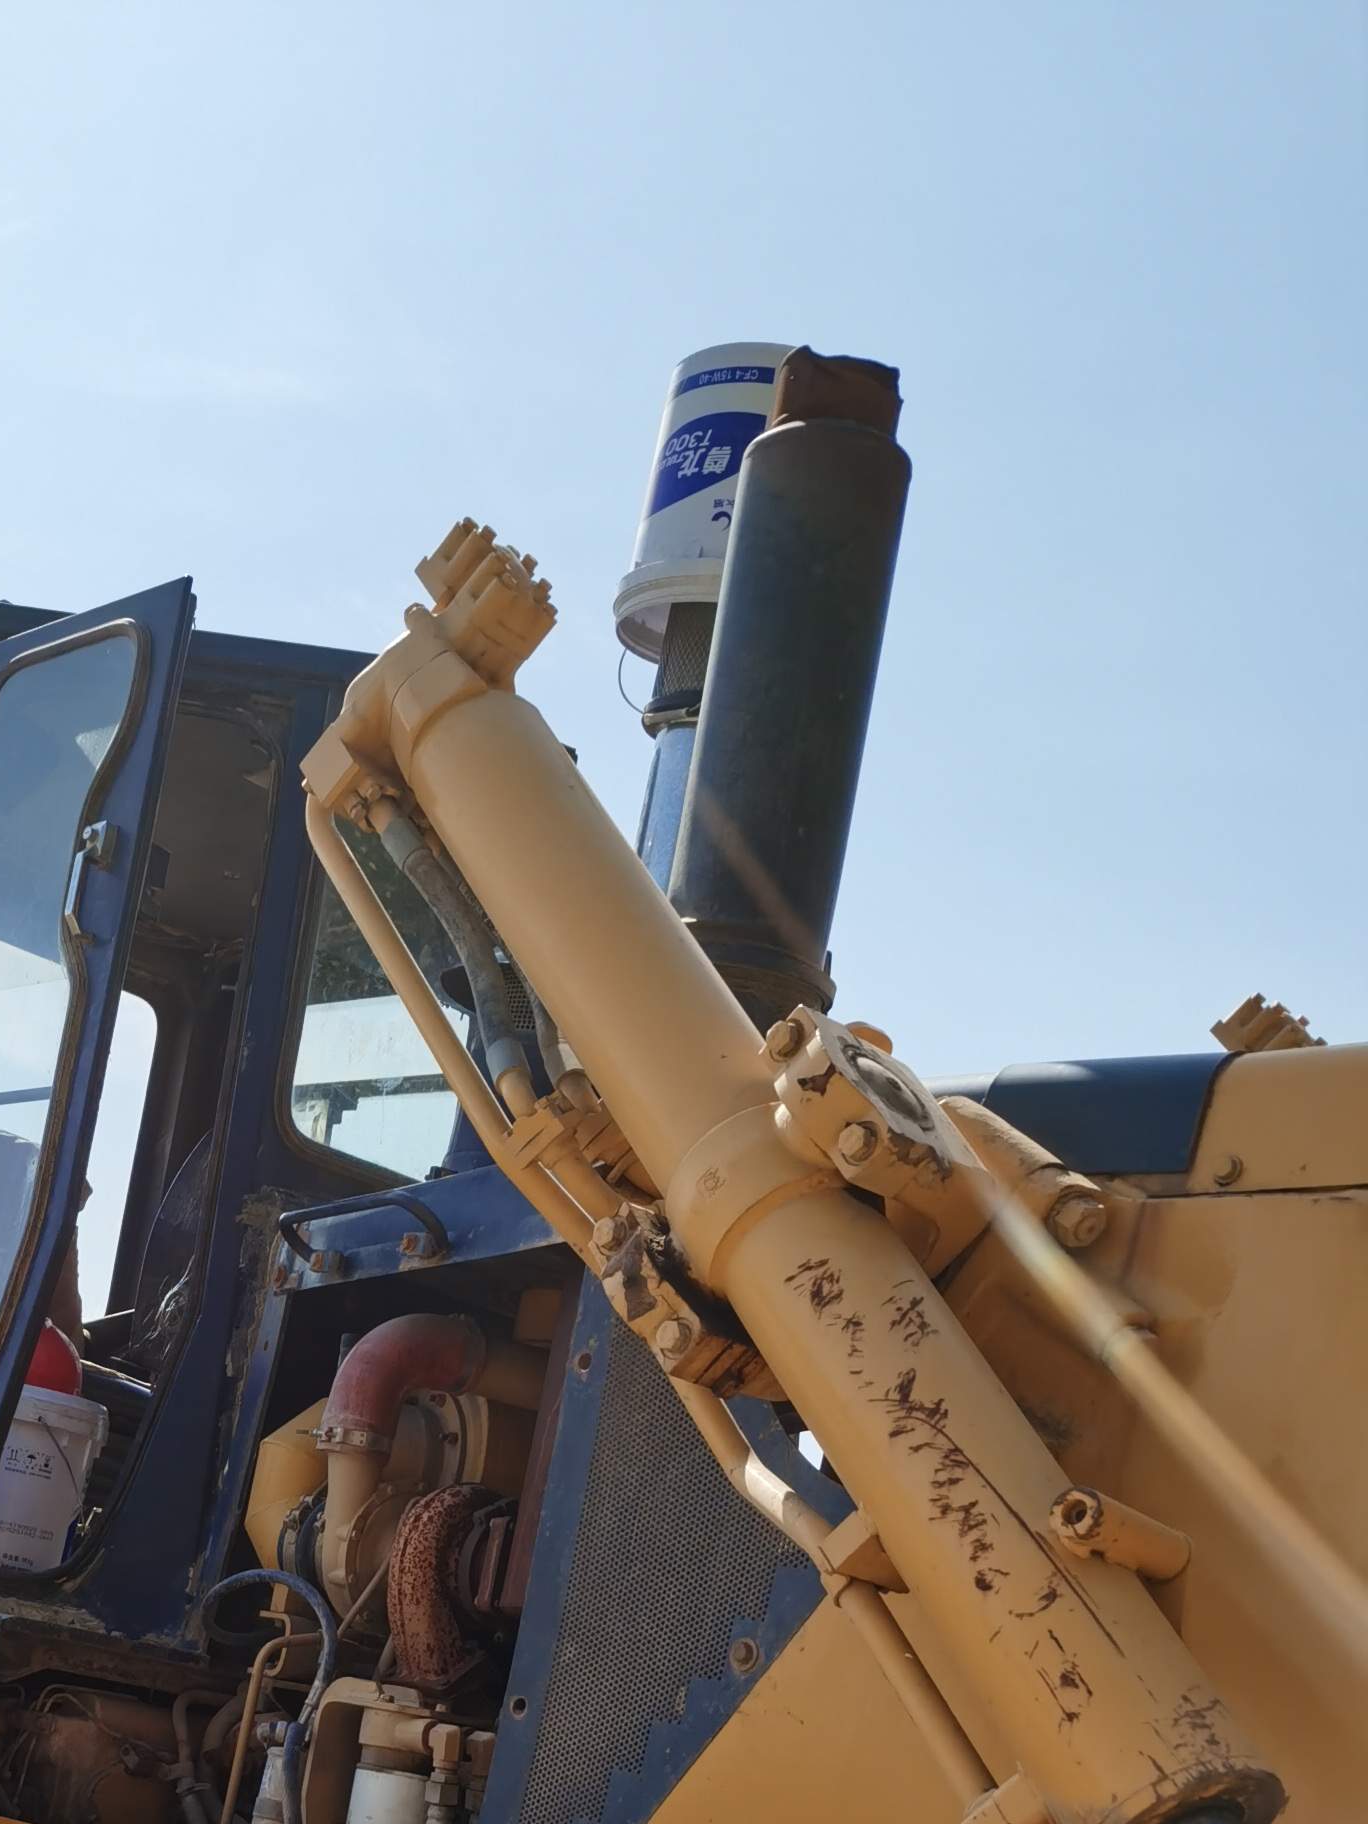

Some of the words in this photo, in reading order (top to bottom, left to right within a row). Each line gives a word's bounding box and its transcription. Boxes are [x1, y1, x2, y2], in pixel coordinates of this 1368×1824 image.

[698, 369, 732, 385] 15W-40
[736, 368, 759, 380] CF-4
[665, 429, 713, 454] T300
